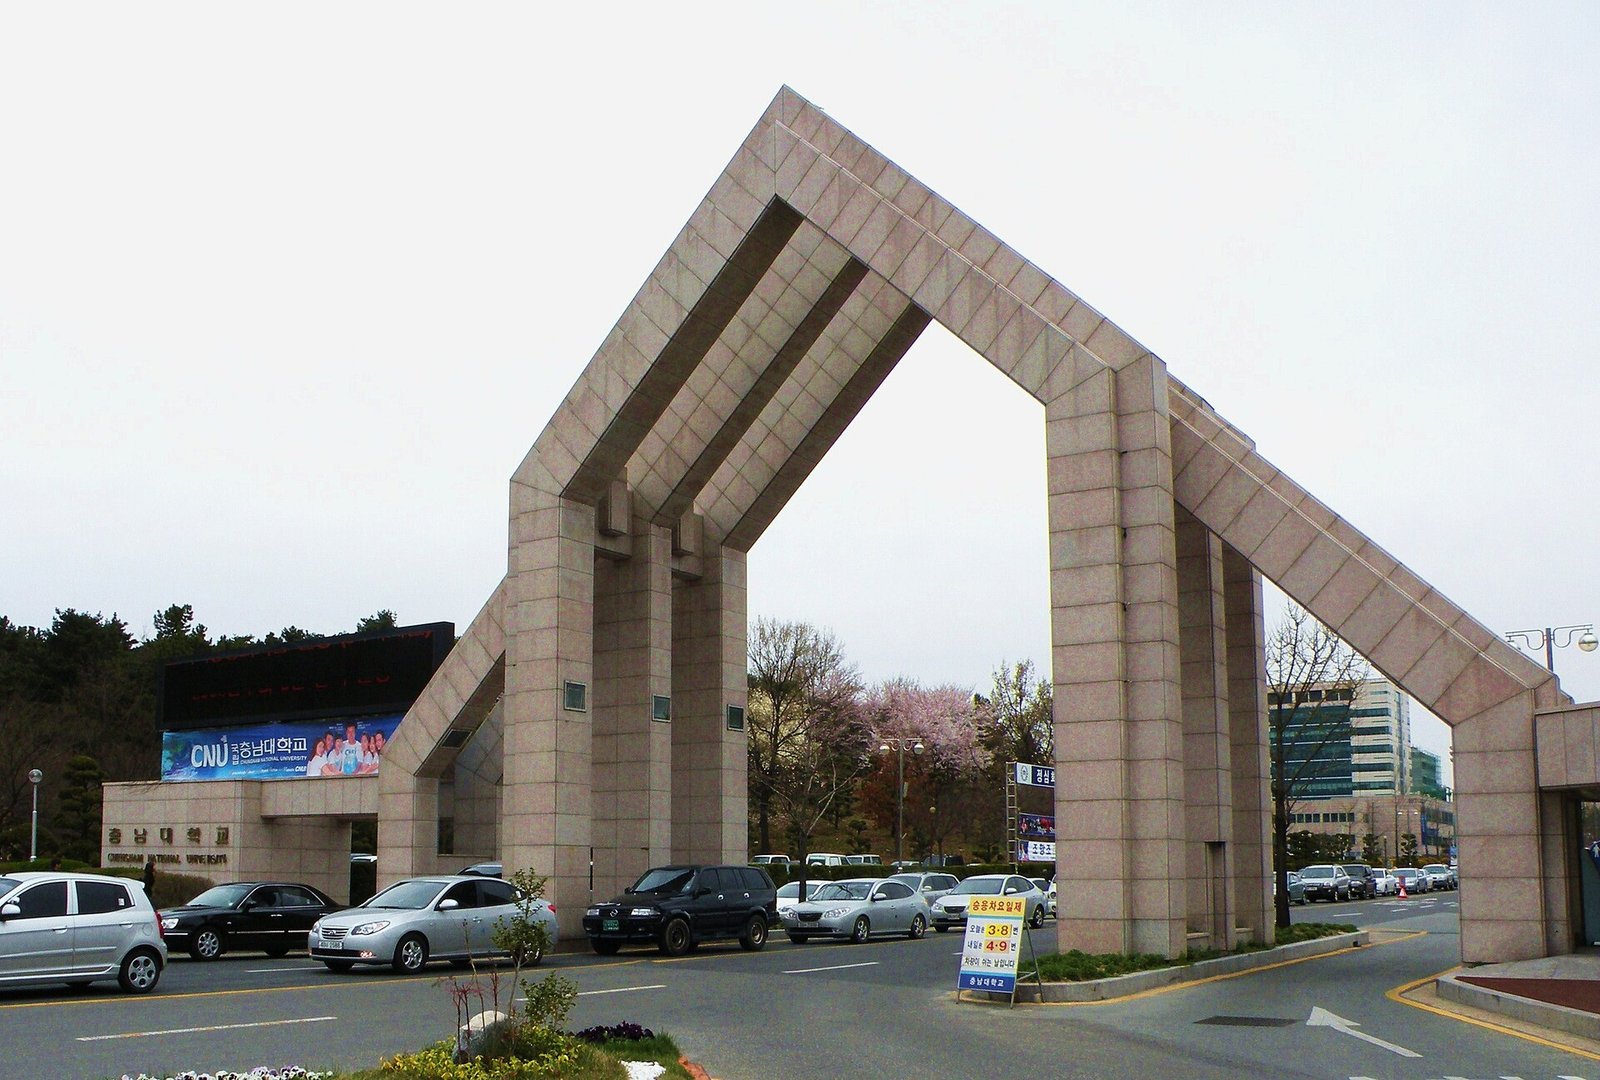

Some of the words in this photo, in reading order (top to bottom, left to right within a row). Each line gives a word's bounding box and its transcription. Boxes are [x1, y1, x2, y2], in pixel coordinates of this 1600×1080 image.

[191, 741, 229, 767] CNU
[240, 737, 308, 758] 충남대학교
[972, 900, 1022, 912] 승용차요일제
